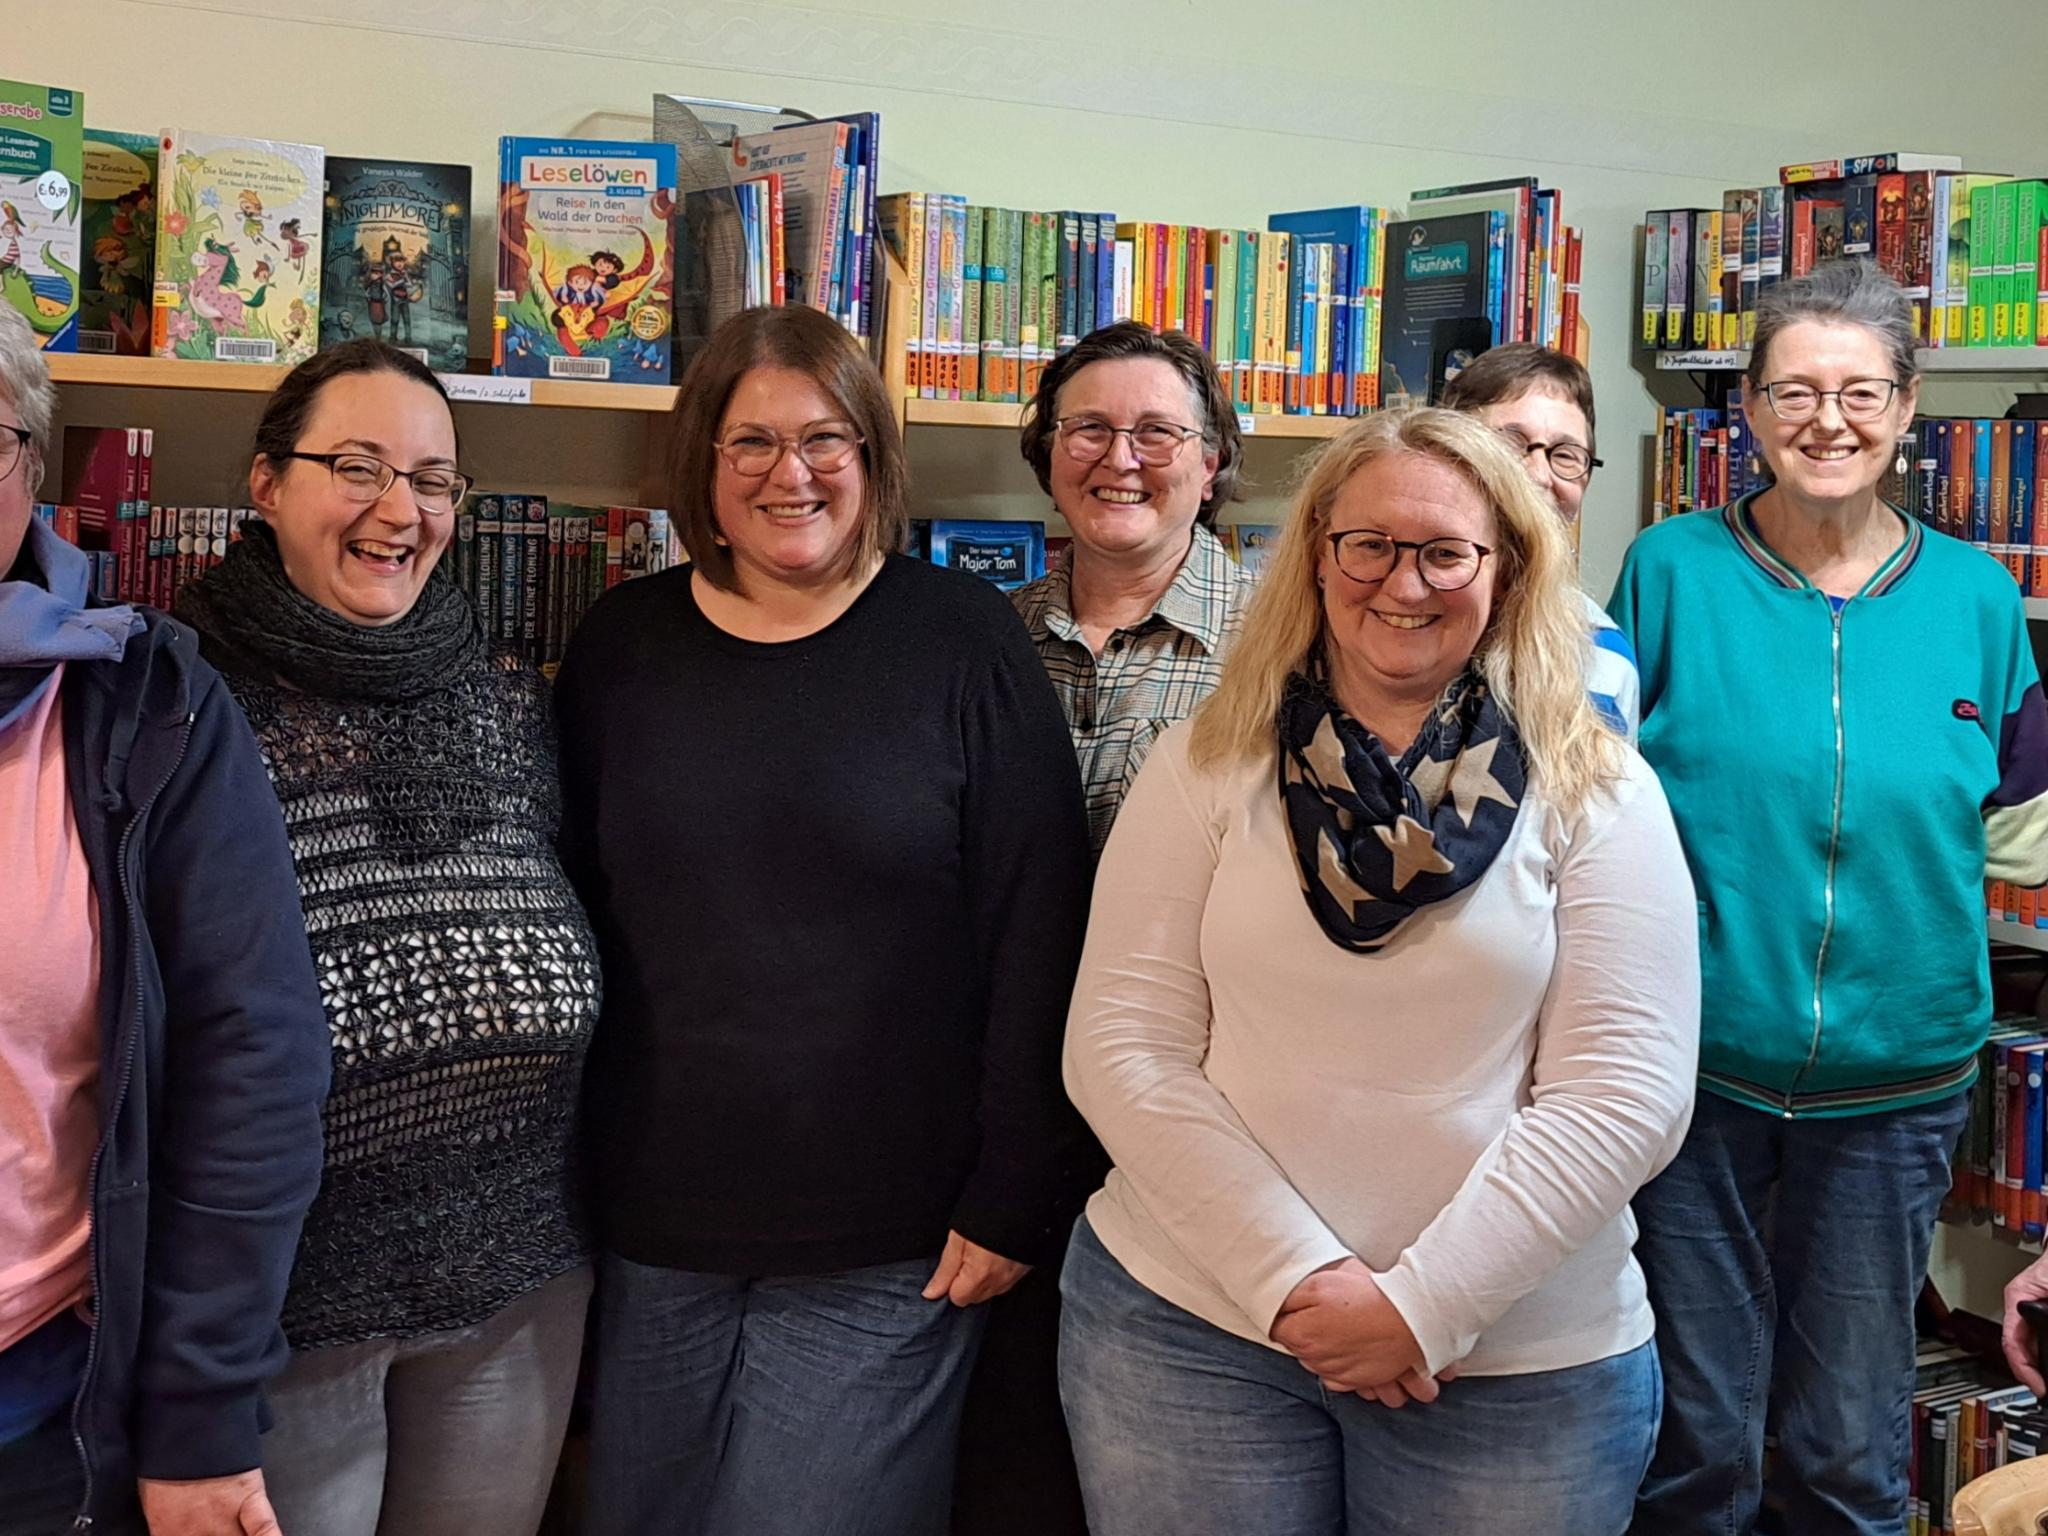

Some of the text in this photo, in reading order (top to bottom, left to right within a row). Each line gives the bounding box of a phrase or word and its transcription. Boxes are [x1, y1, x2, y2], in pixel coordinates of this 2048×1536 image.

[361, 166, 425, 178] Vanessa Walder
[529, 162, 648, 184] Leselöwen
[1853, 157, 1876, 174] SPY
[343, 202, 437, 225] NIGHTMORE
[556, 196, 625, 210] Reise in den
[538, 210, 643, 224] Wald der Drachen
[1711, 235, 1719, 270] LÖCHER
[853, 250, 861, 288] Computer
[1411, 256, 1462, 273] Raumfahrt
[1646, 264, 1661, 286] P
[1030, 286, 1038, 326] WANDLER
[958, 554, 1017, 572] Major Tom
[504, 536, 516, 638] DER KLEINE FLOHLING
[525, 538, 537, 639] DER KLEINE FLOHLING
